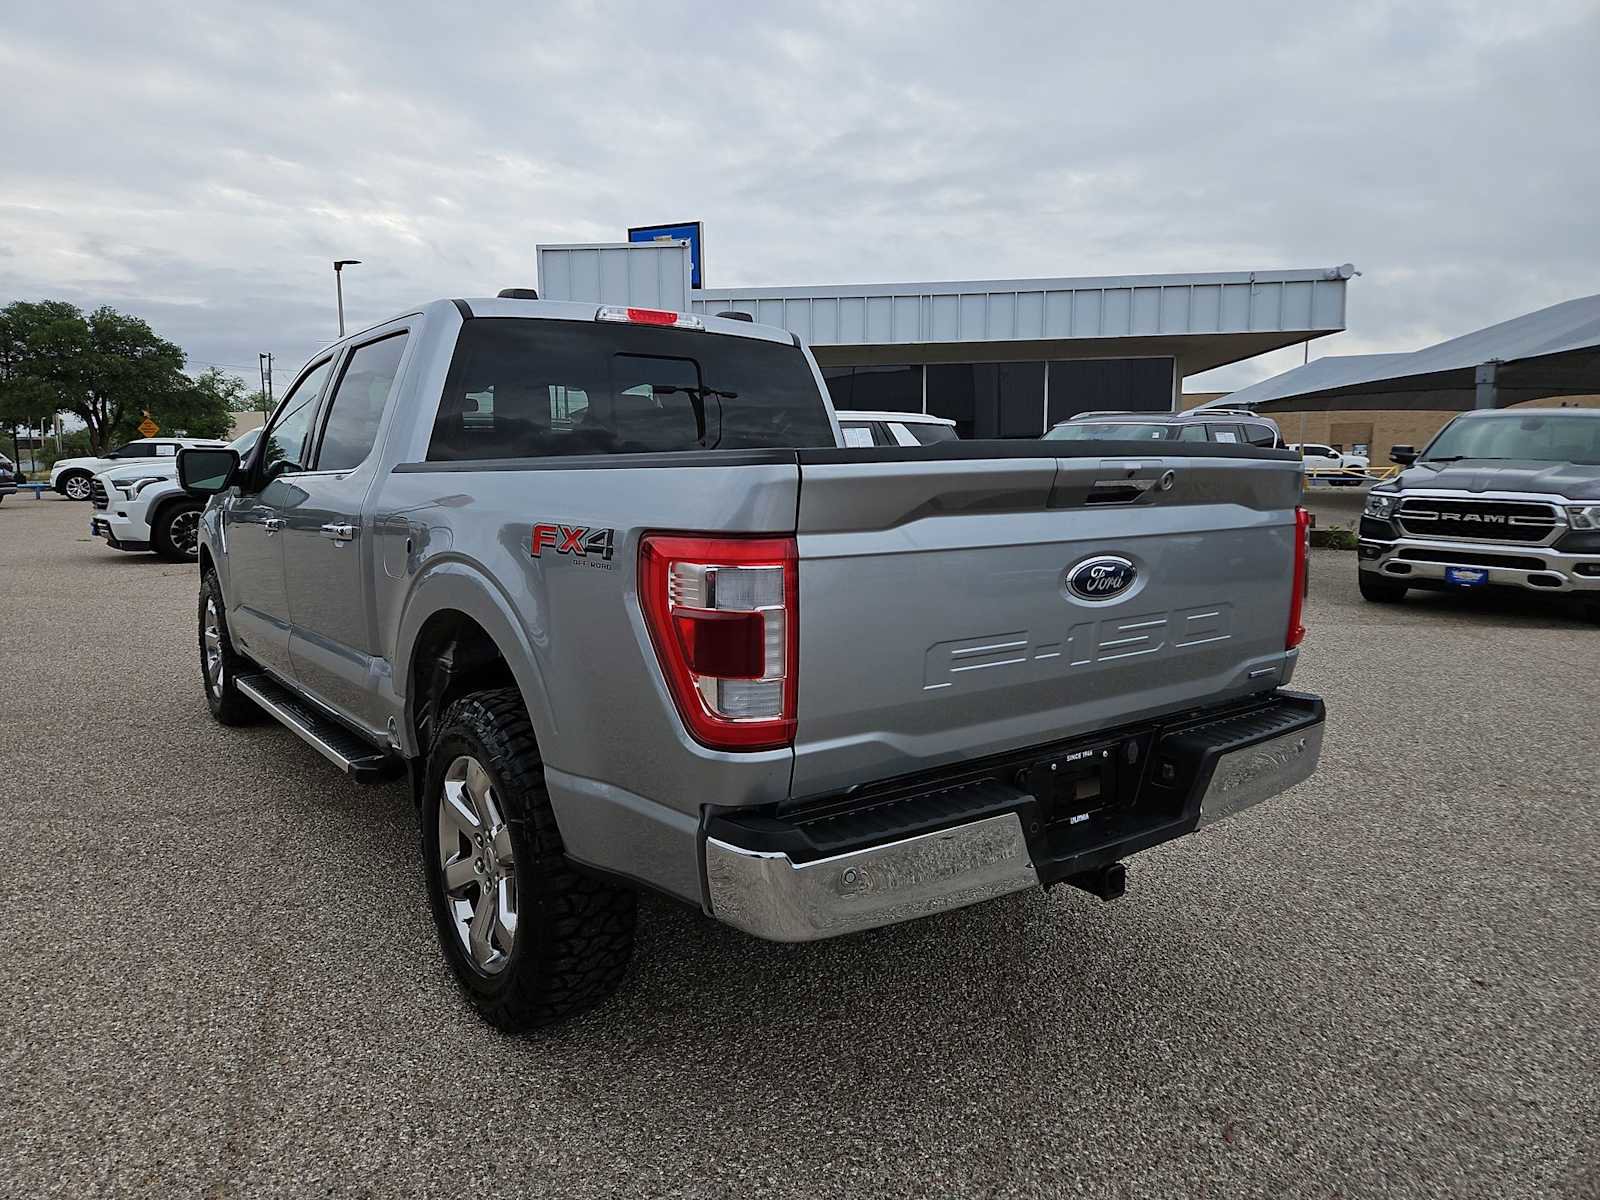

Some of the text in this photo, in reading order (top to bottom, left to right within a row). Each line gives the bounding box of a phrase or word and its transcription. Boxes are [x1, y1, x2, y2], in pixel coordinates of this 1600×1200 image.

[1441, 512, 1505, 523] RAM
[531, 522, 614, 560] FX4
[590, 561, 612, 570] ROAD
[1086, 565, 1124, 591] Ford
[922, 601, 1235, 690] F-150
[1066, 751, 1081, 761] SINCE
